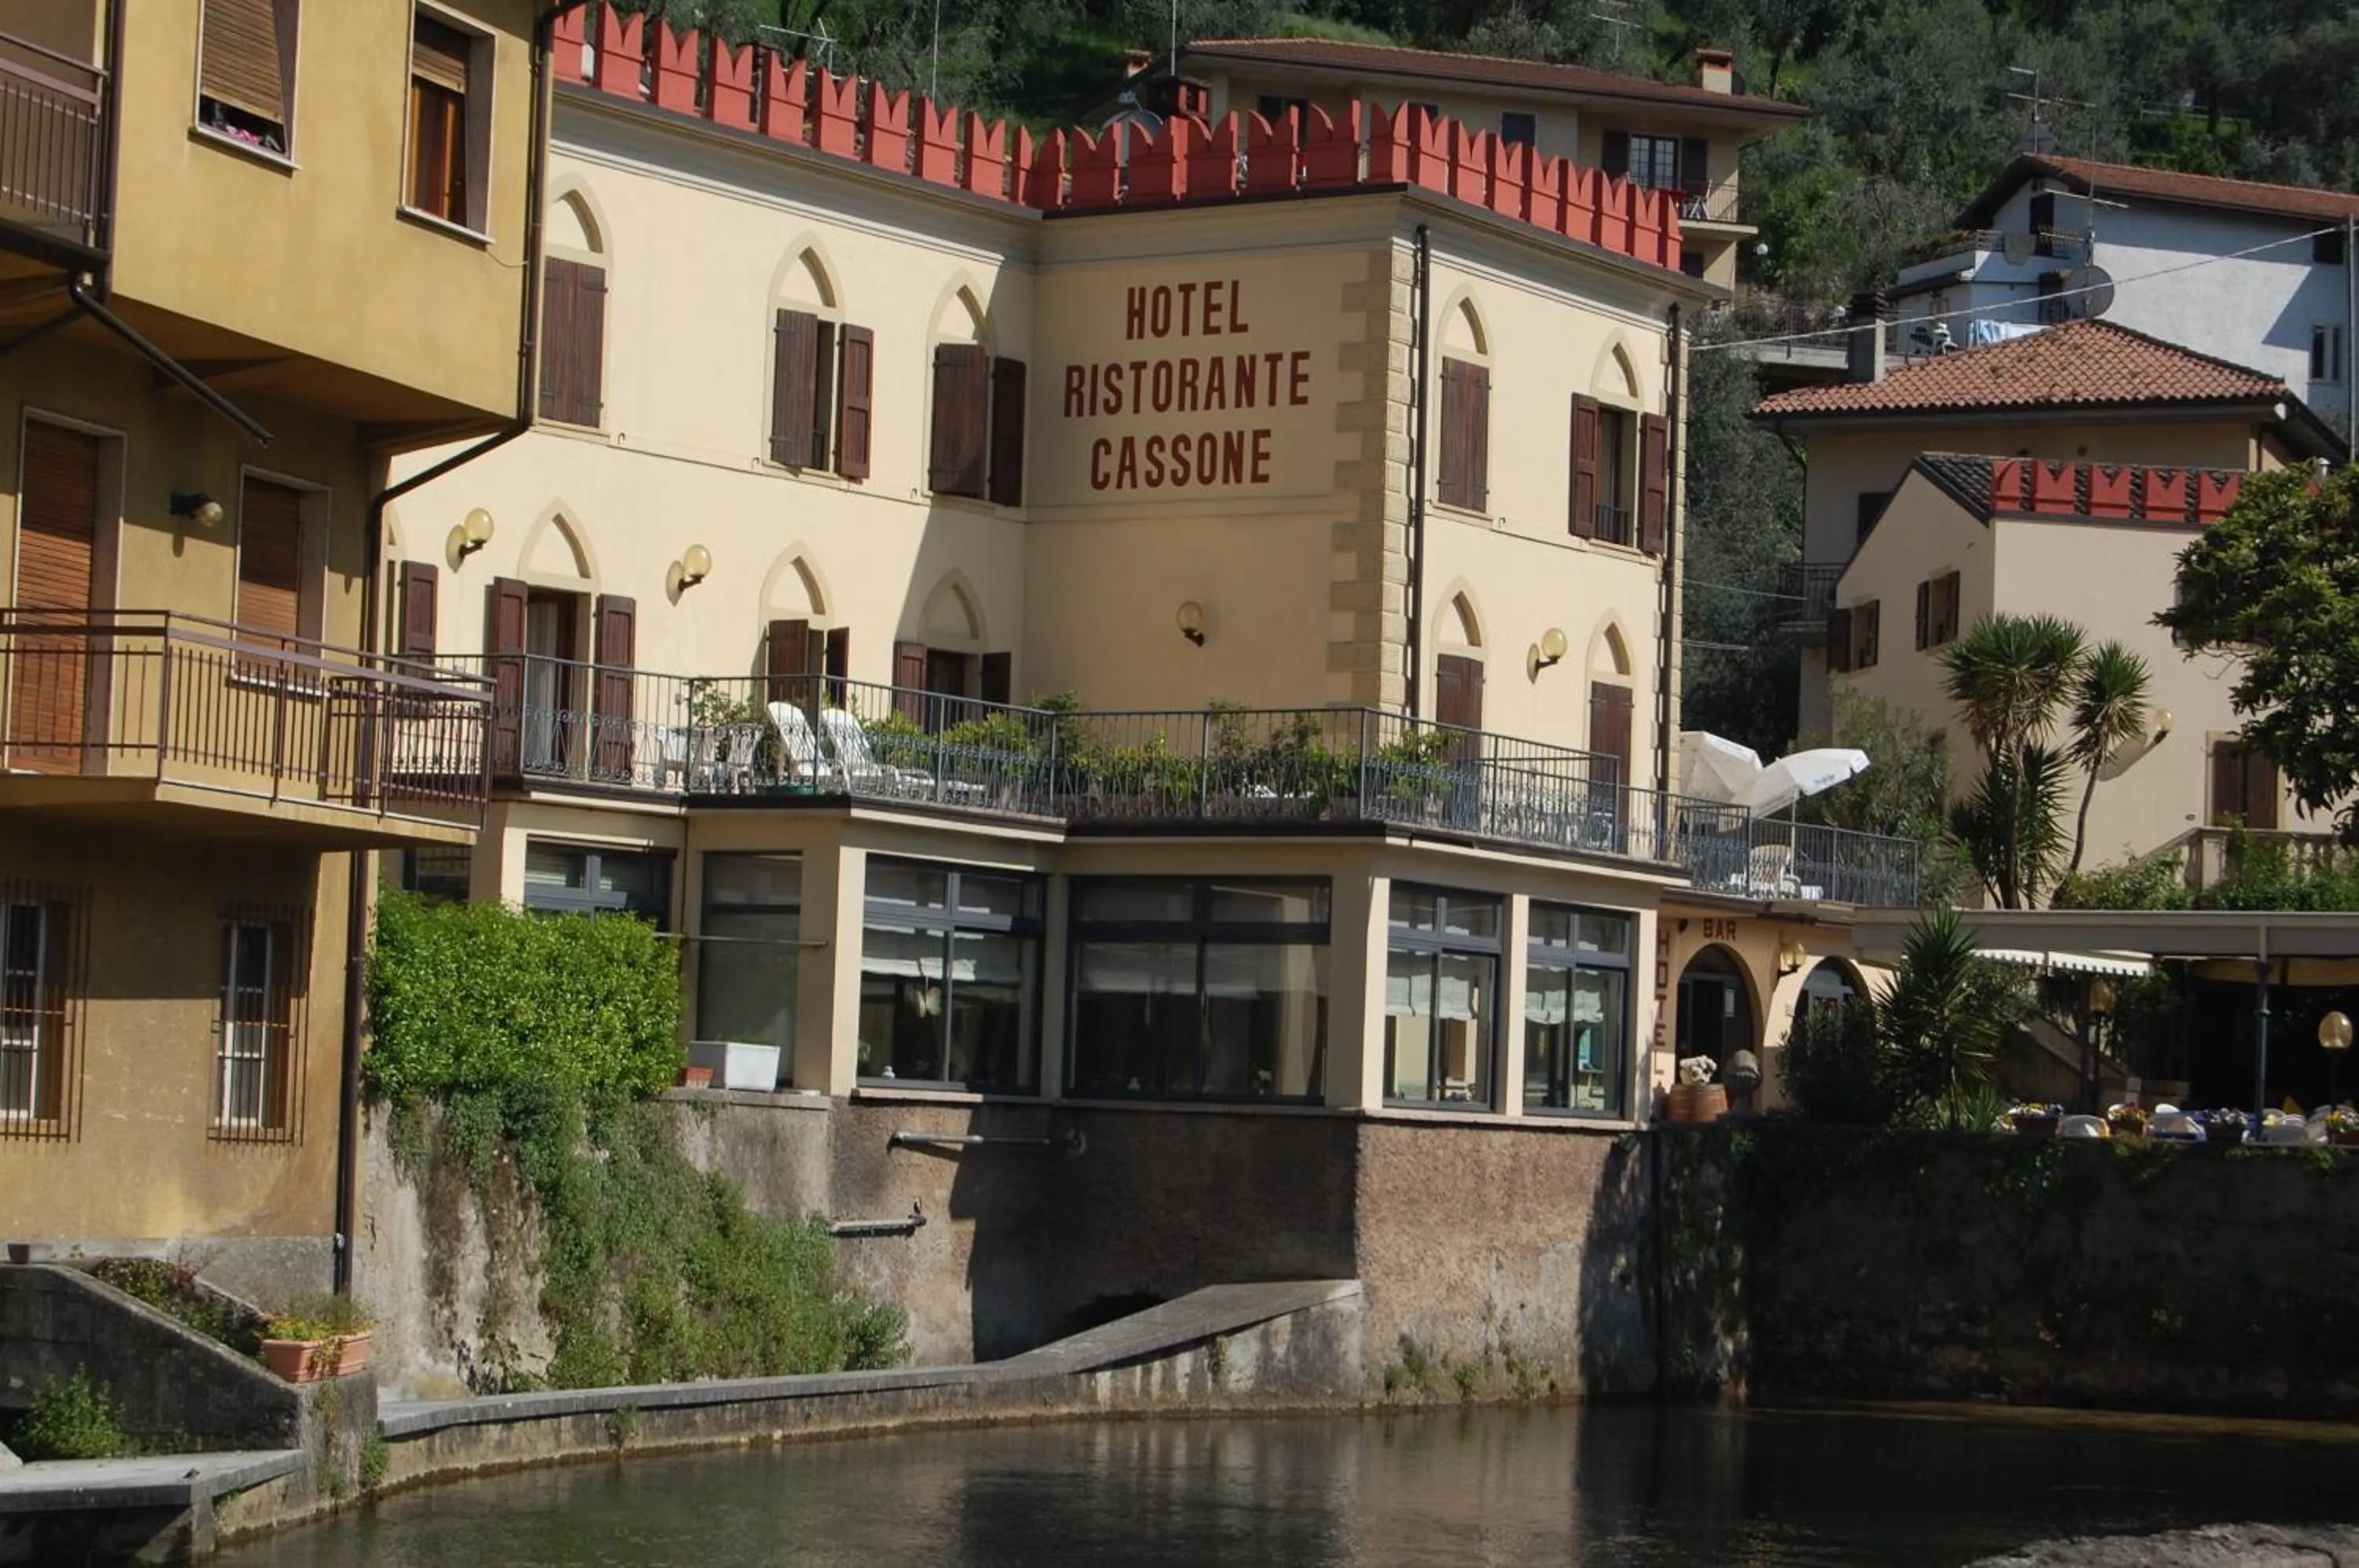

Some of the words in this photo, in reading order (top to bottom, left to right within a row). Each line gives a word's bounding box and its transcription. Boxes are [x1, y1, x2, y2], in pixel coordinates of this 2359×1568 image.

[1126, 279, 1249, 340] HOTEL
[1064, 351, 1310, 418] RISTORANTE
[1090, 429, 1272, 491] CASSONE
[1703, 918, 1737, 940] BAR
[1654, 929, 1669, 1075] HOTEL
